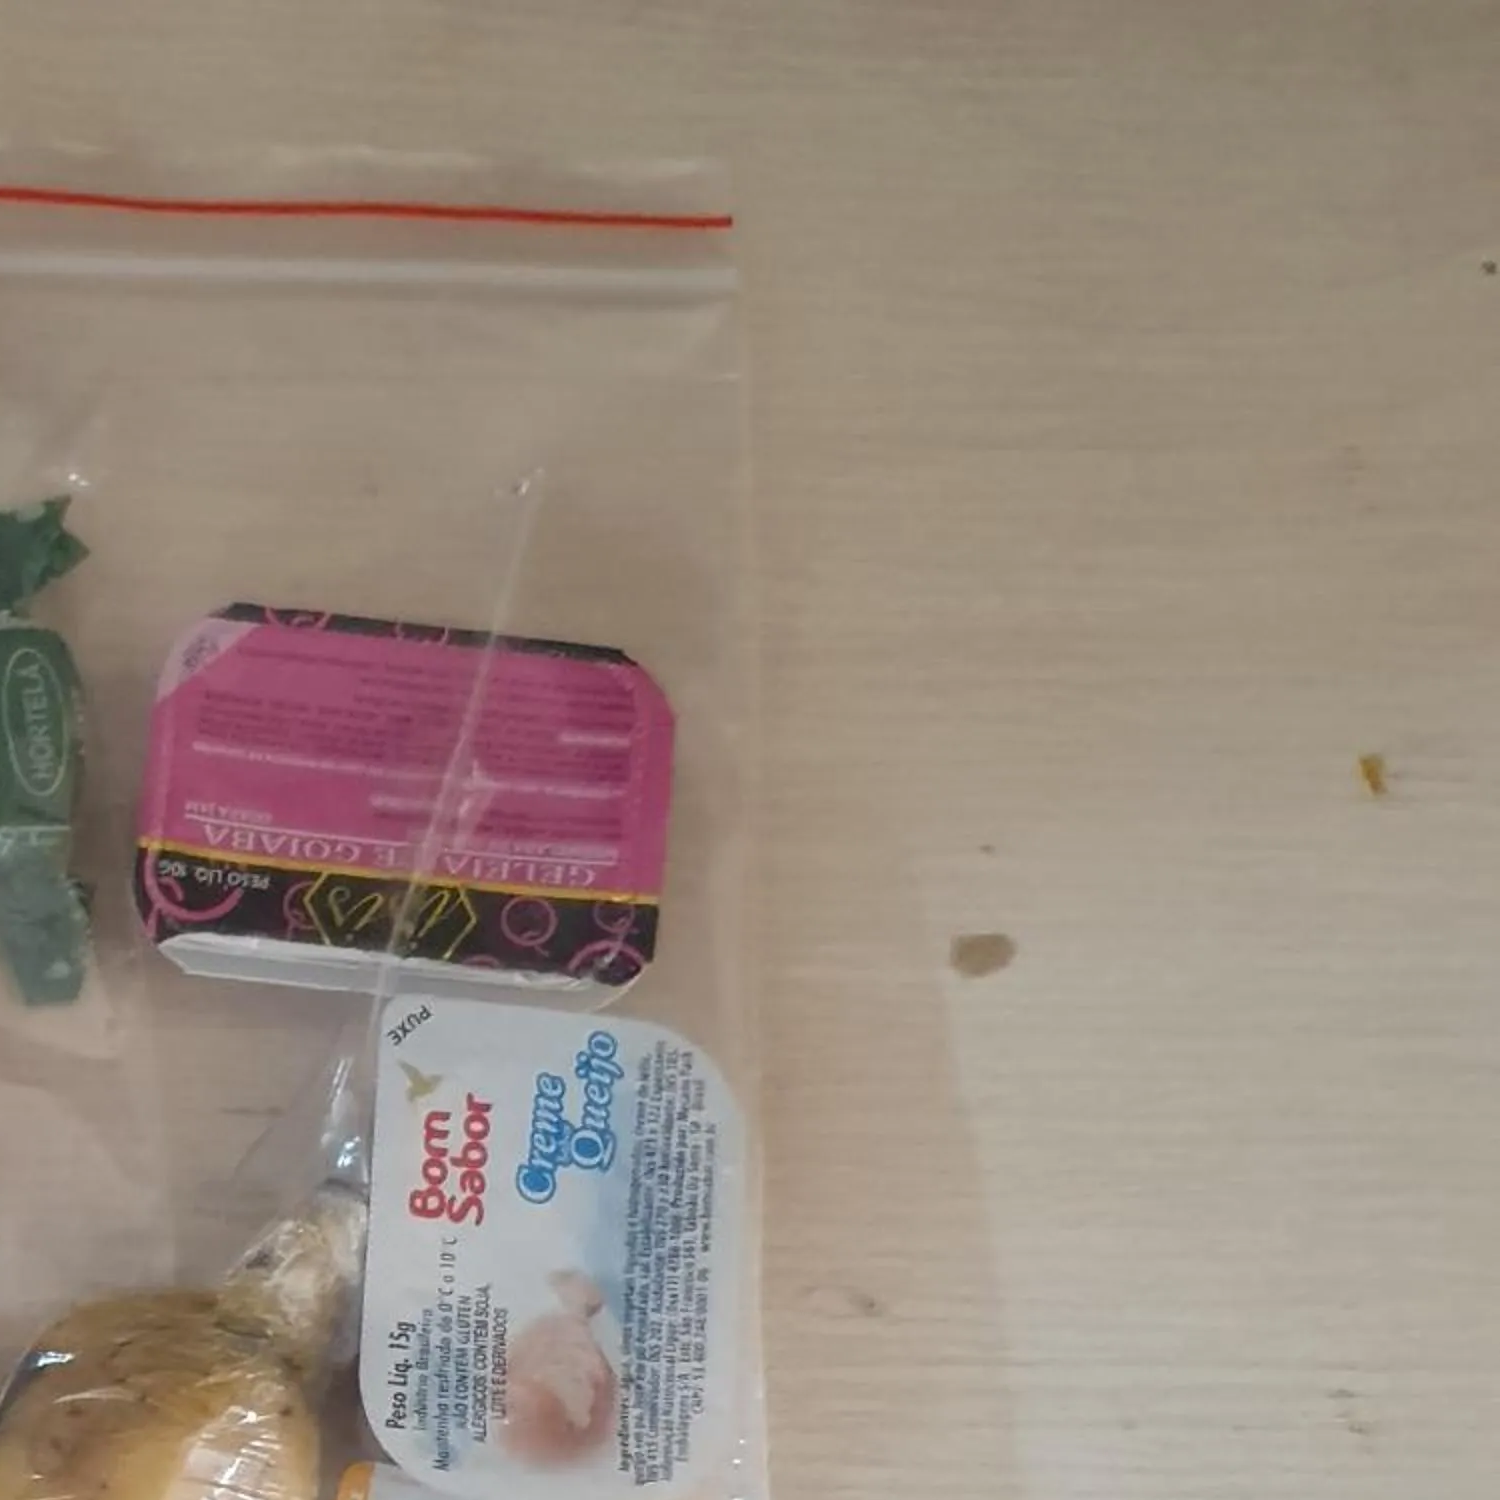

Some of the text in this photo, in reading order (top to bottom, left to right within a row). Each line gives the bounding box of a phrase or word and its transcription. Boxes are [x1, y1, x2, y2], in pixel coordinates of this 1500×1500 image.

[203, 823, 360, 863] GOIABA
[386, 1003, 434, 1047] PUXE
[516, 1072, 566, 1204] Creme
[570, 1030, 624, 1172] Queijo
[409, 1110, 452, 1219] Bom
[446, 1091, 493, 1226] Sabor
[388, 1321, 416, 1350] 15g
[385, 1392, 407, 1429] Peso
